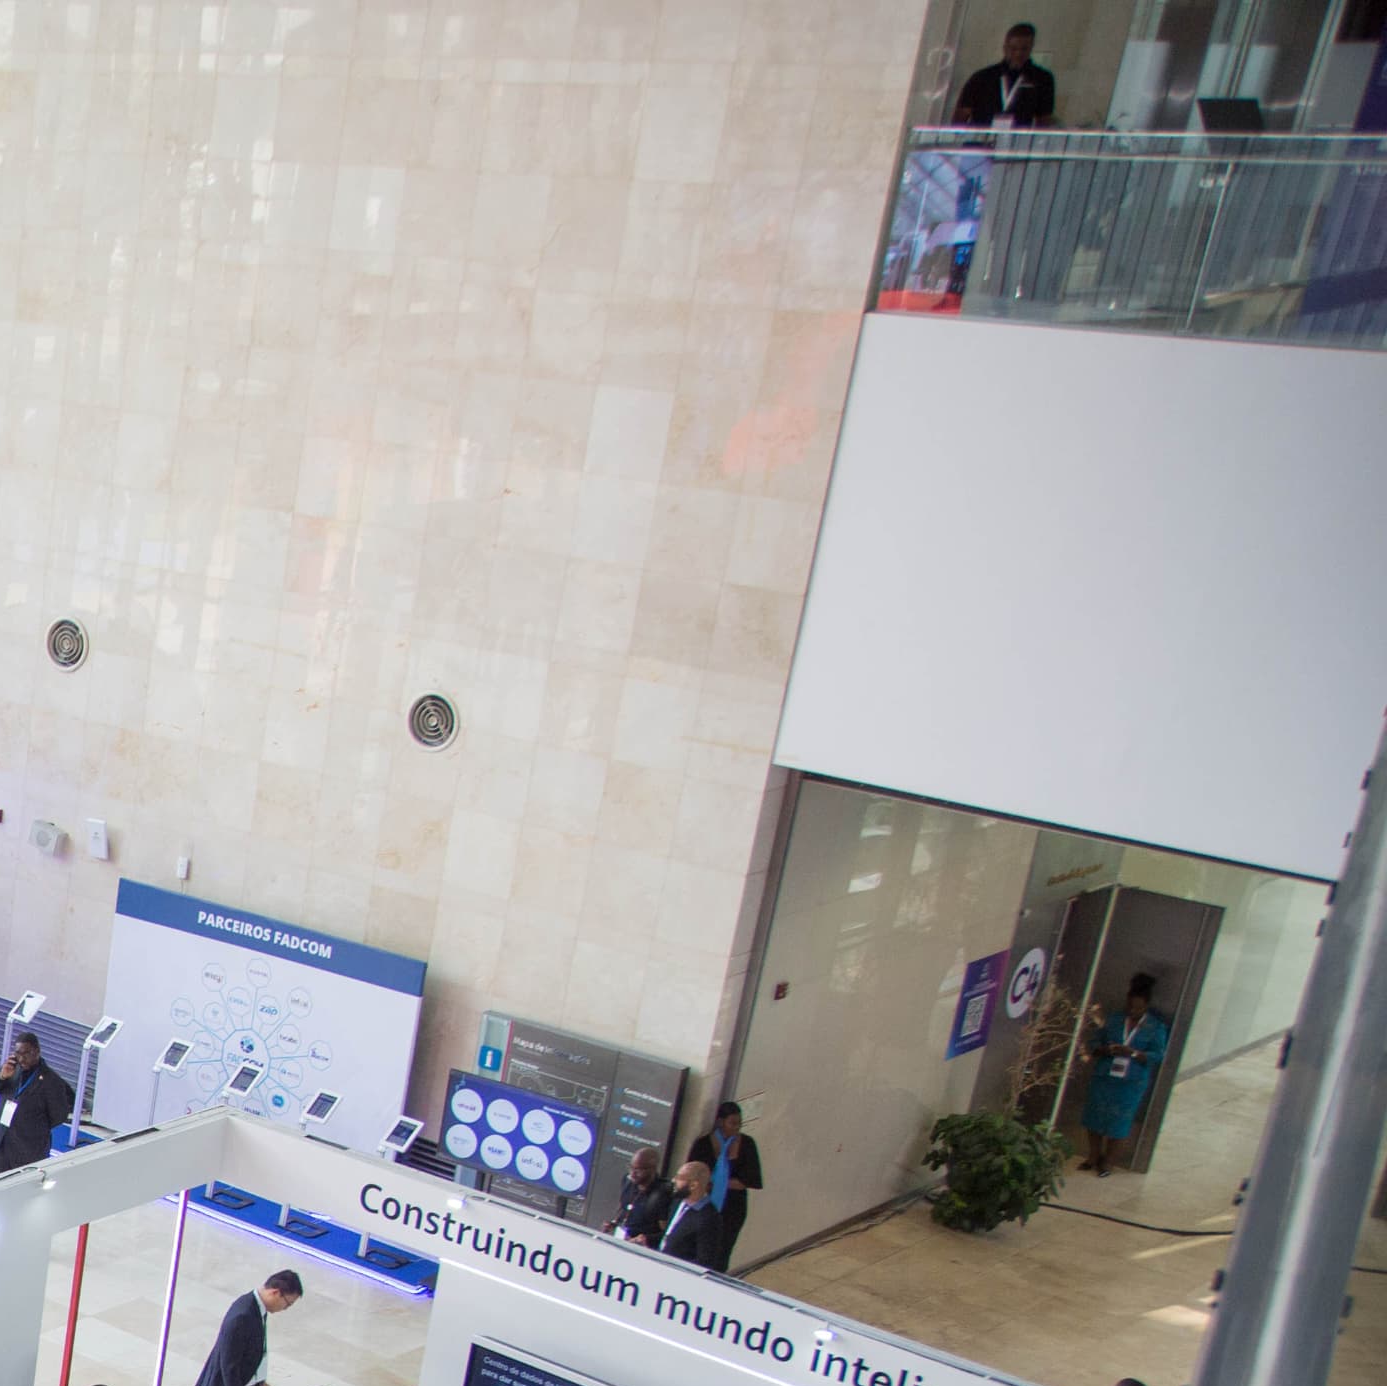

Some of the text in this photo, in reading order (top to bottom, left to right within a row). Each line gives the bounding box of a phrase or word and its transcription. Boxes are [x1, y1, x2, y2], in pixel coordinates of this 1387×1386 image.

[197, 911, 332, 959] PARCEIROS FADCOM
[1011, 963, 1040, 1004] C4
[359, 1183, 574, 1283] Construindo
[581, 1265, 640, 1307] um
[654, 1292, 794, 1363] mundo
[481, 1367, 498, 1380] para
[498, 1373, 512, 1385] dar
[483, 1355, 508, 1372] Centro
[509, 1366, 519, 1376] de
[519, 1370, 543, 1385] dados
